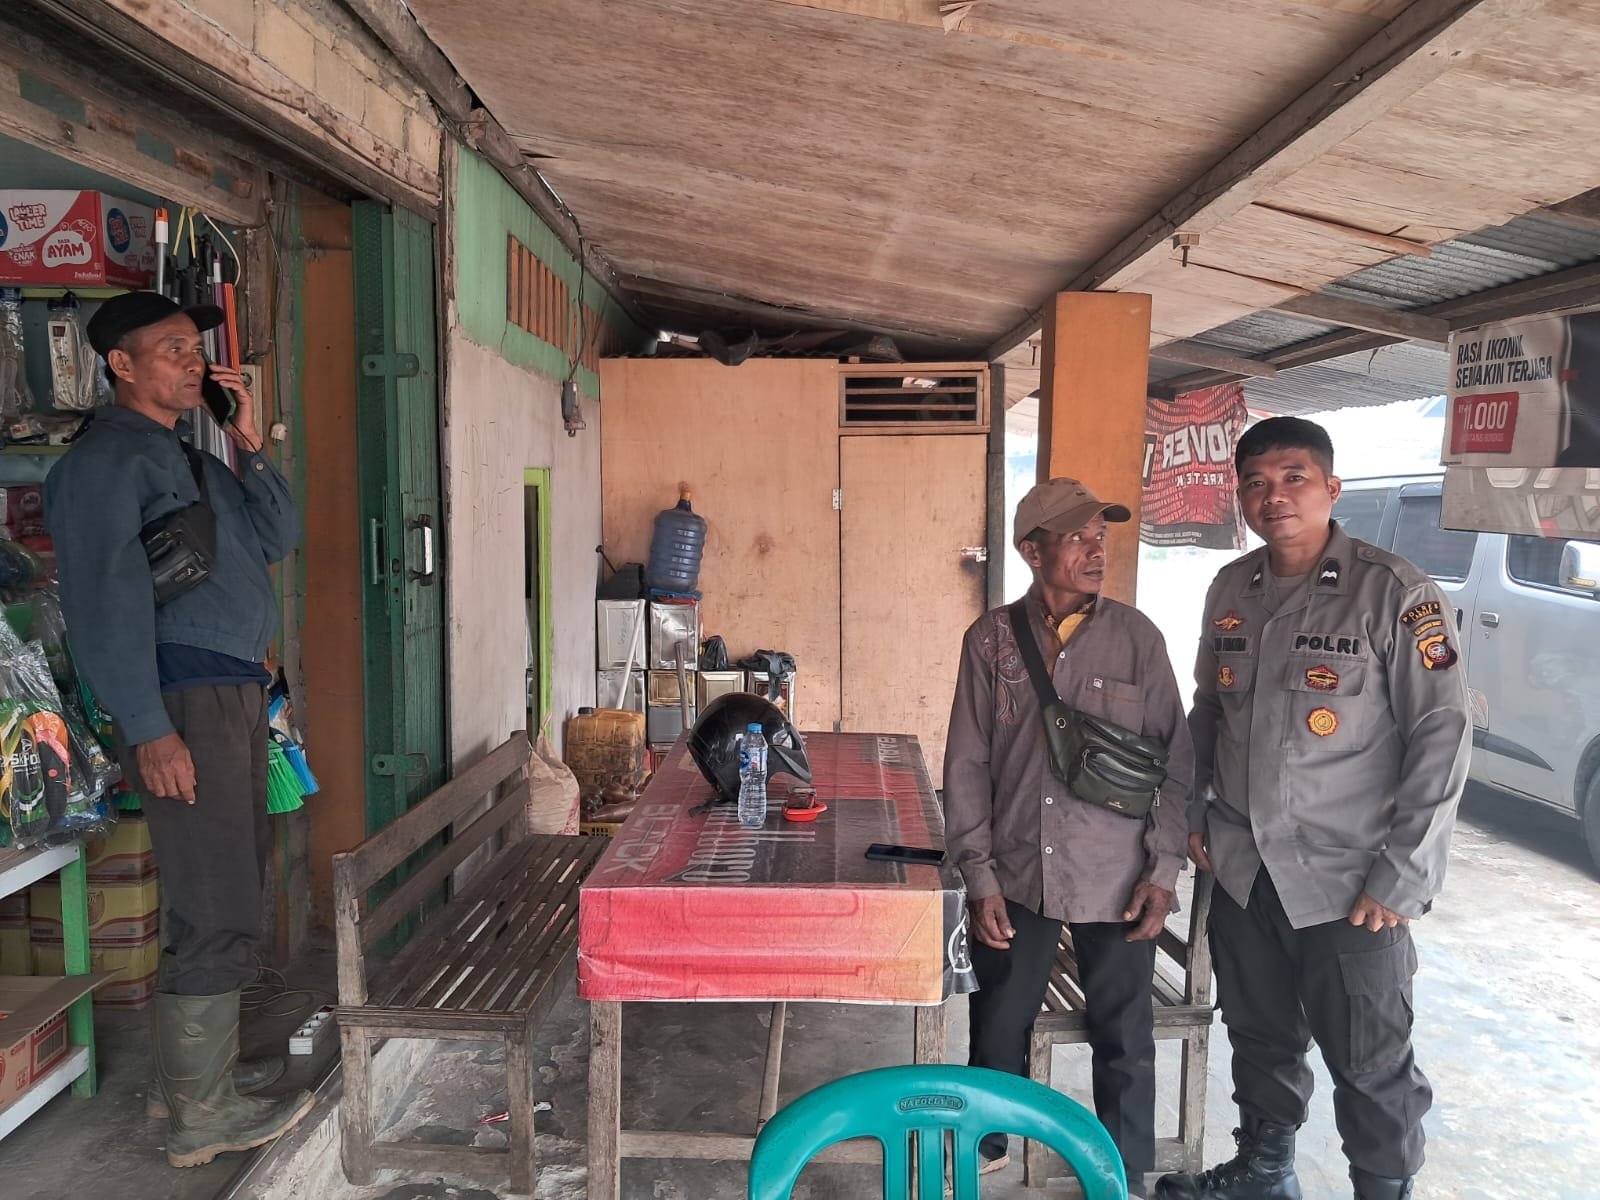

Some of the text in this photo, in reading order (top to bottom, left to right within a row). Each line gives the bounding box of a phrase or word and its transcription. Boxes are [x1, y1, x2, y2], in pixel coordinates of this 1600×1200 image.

[16, 217, 45, 231] TIME
[48, 243, 84, 258] AYAM
[1457, 342, 1482, 365] RASA
[1456, 356, 1553, 388] SEMAKIN TERJAGA
[1295, 635, 1360, 655] POLRI
[604, 804, 680, 873] BLACK
